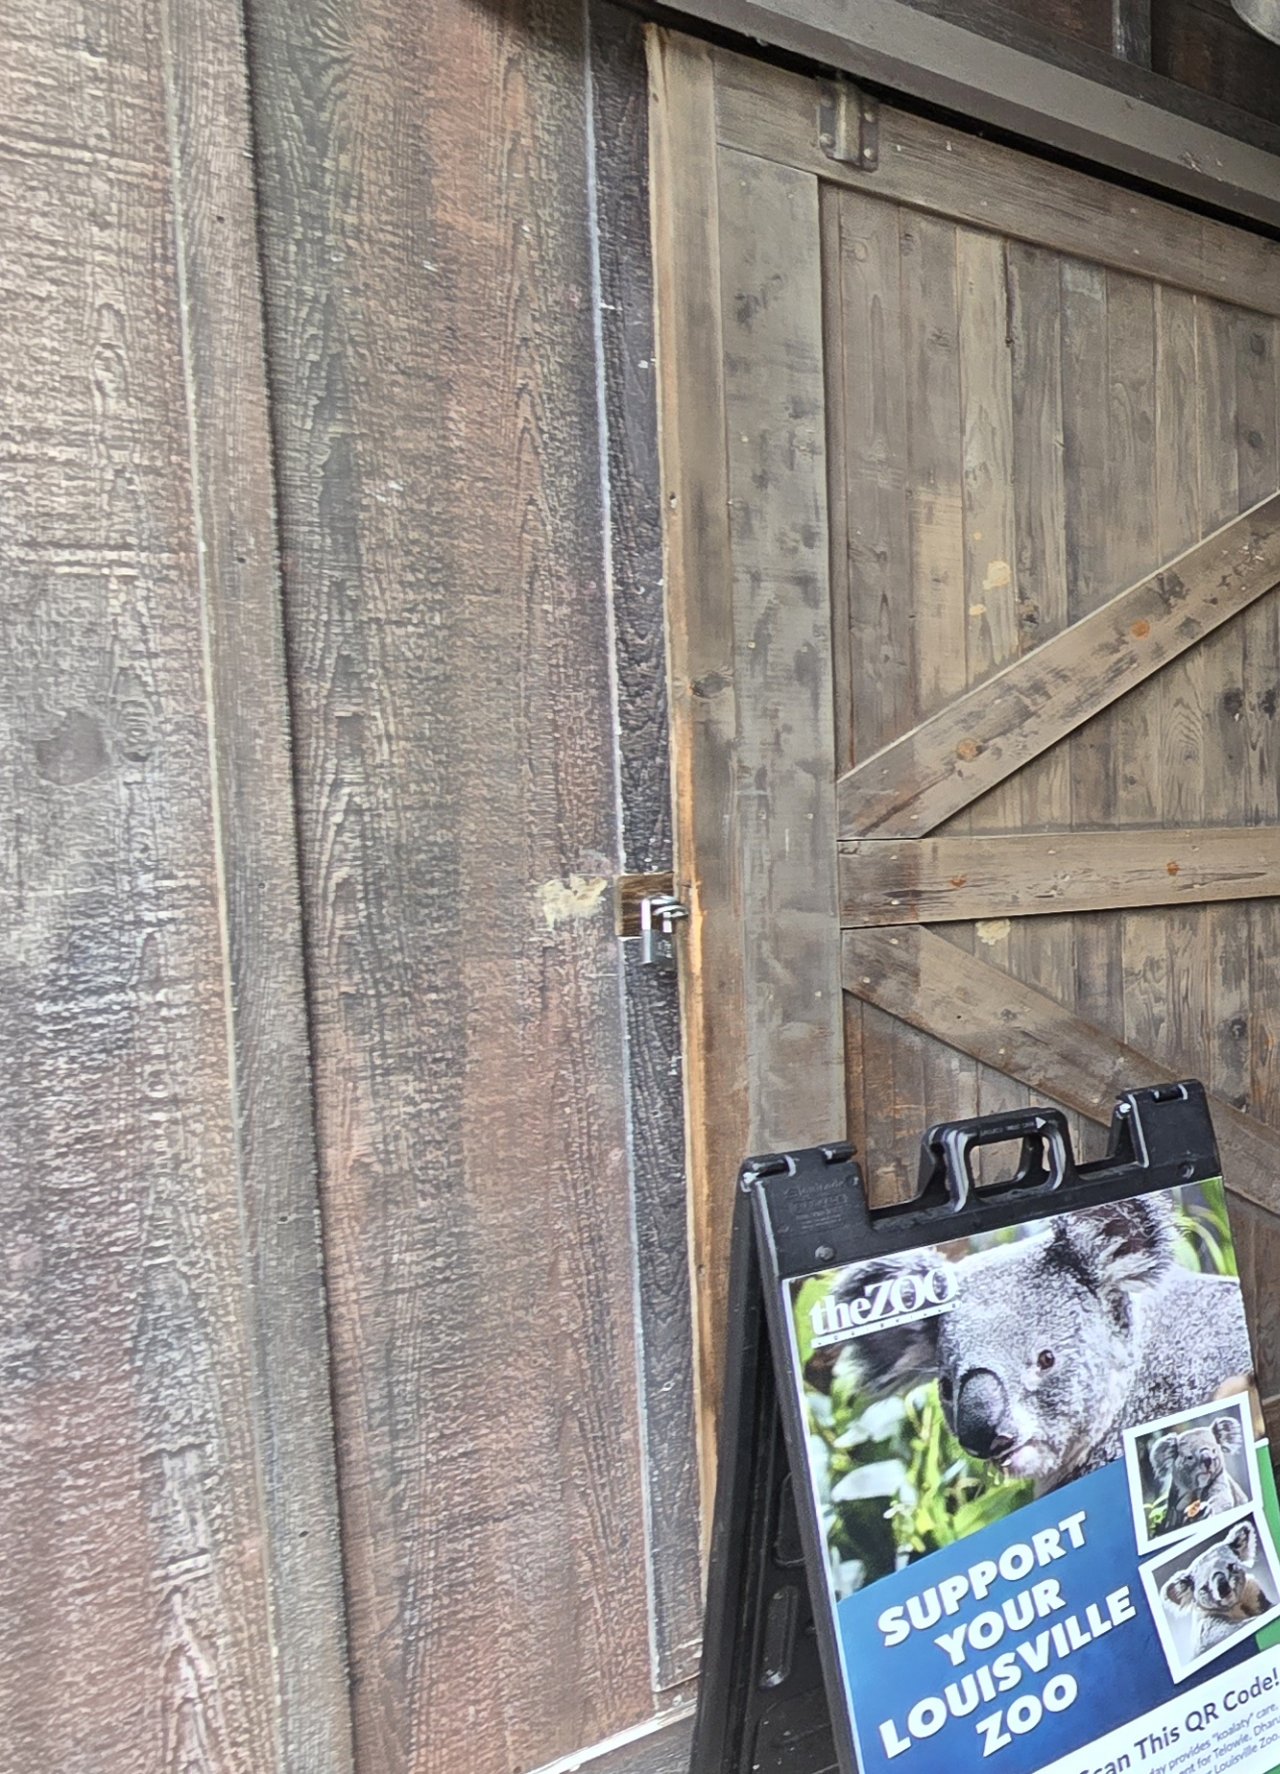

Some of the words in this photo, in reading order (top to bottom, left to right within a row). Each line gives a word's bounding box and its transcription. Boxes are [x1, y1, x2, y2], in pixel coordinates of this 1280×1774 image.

[877, 1510, 1086, 1647] SUPPORT
[933, 1578, 1067, 1667] YOUR
[878, 1585, 1137, 1760] LOUISVILLE
[975, 1673, 1078, 1758] ZOO
[1133, 1725, 1181, 1760] This
[1184, 1702, 1220, 1732] QR
[1222, 1667, 1280, 1712] Code!
[1168, 1740, 1212, 1771] provides
[1197, 1754, 1212, 1769] for
[1214, 1744, 1258, 1774] Louisville
